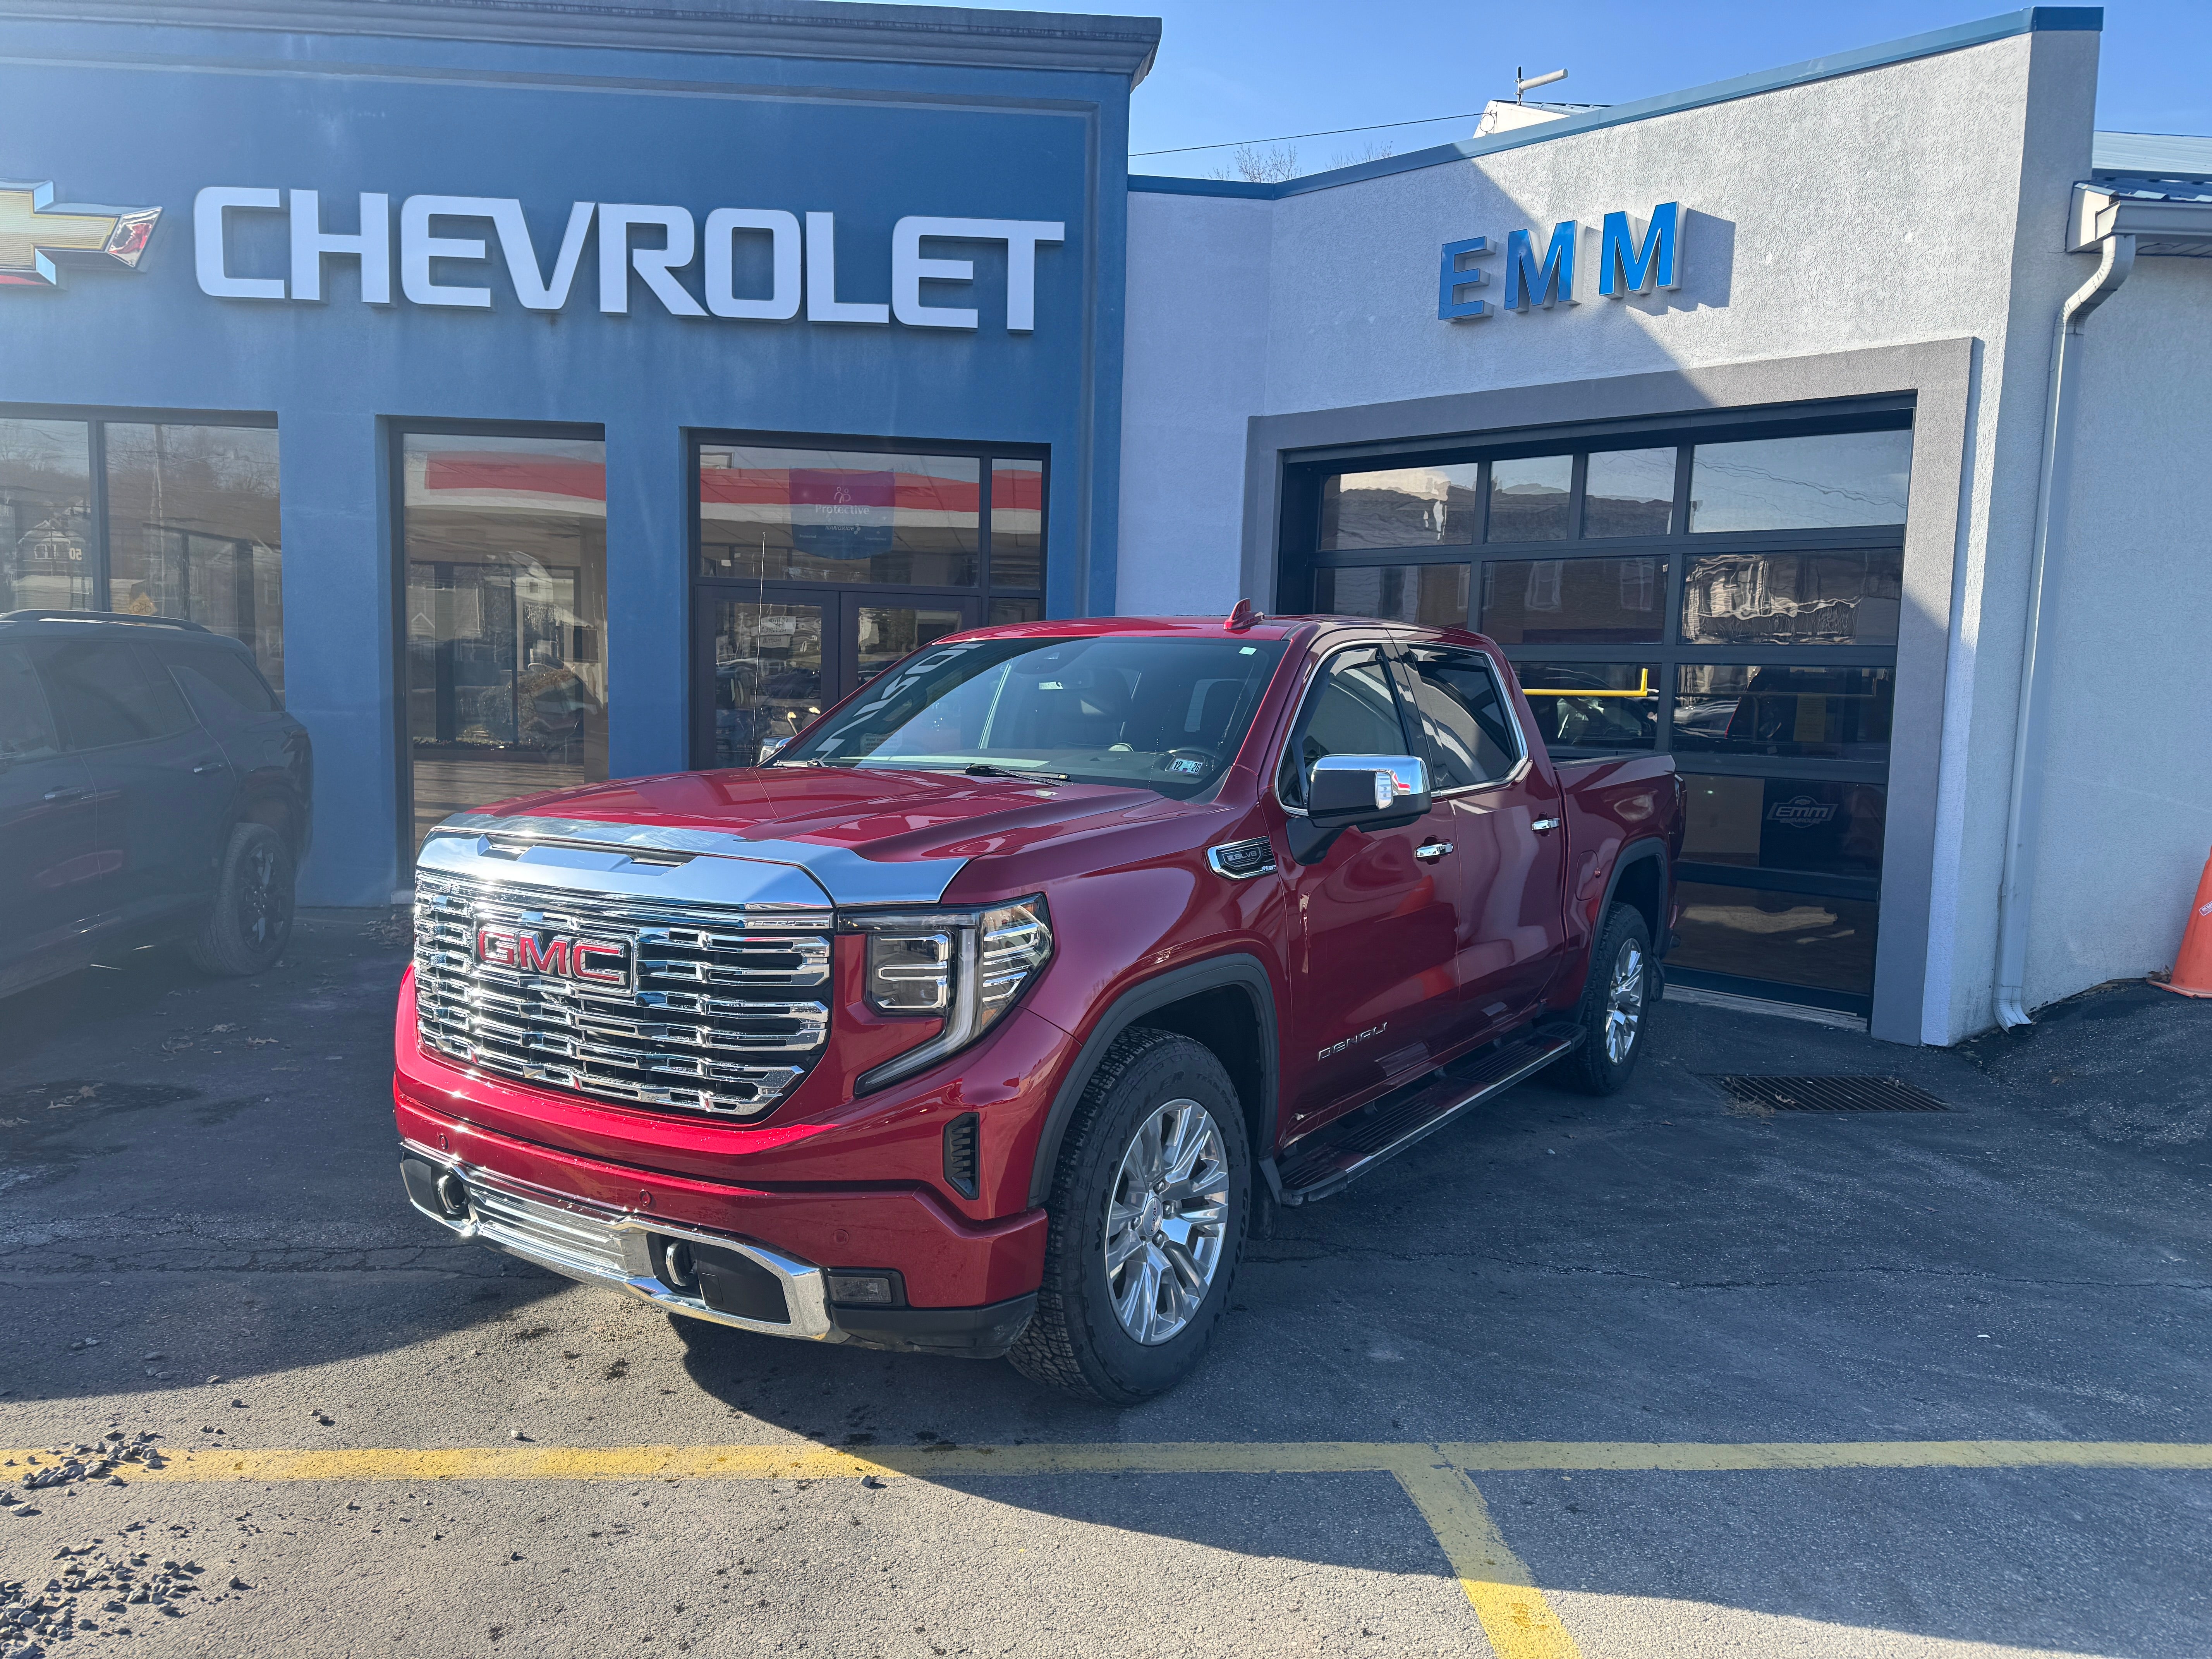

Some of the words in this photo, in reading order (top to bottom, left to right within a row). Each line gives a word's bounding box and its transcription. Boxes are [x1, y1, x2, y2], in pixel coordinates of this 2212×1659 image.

[194, 187, 1065, 333] CHEVROLET
[1438, 201, 1685, 324] EMM
[815, 504, 870, 515] Protective
[1174, 761, 1183, 770] 12
[1191, 763, 1201, 772] 26
[1776, 807, 1829, 817] EMM
[479, 924, 626, 985] GMC
[1317, 1022, 1388, 1061] DENALI
